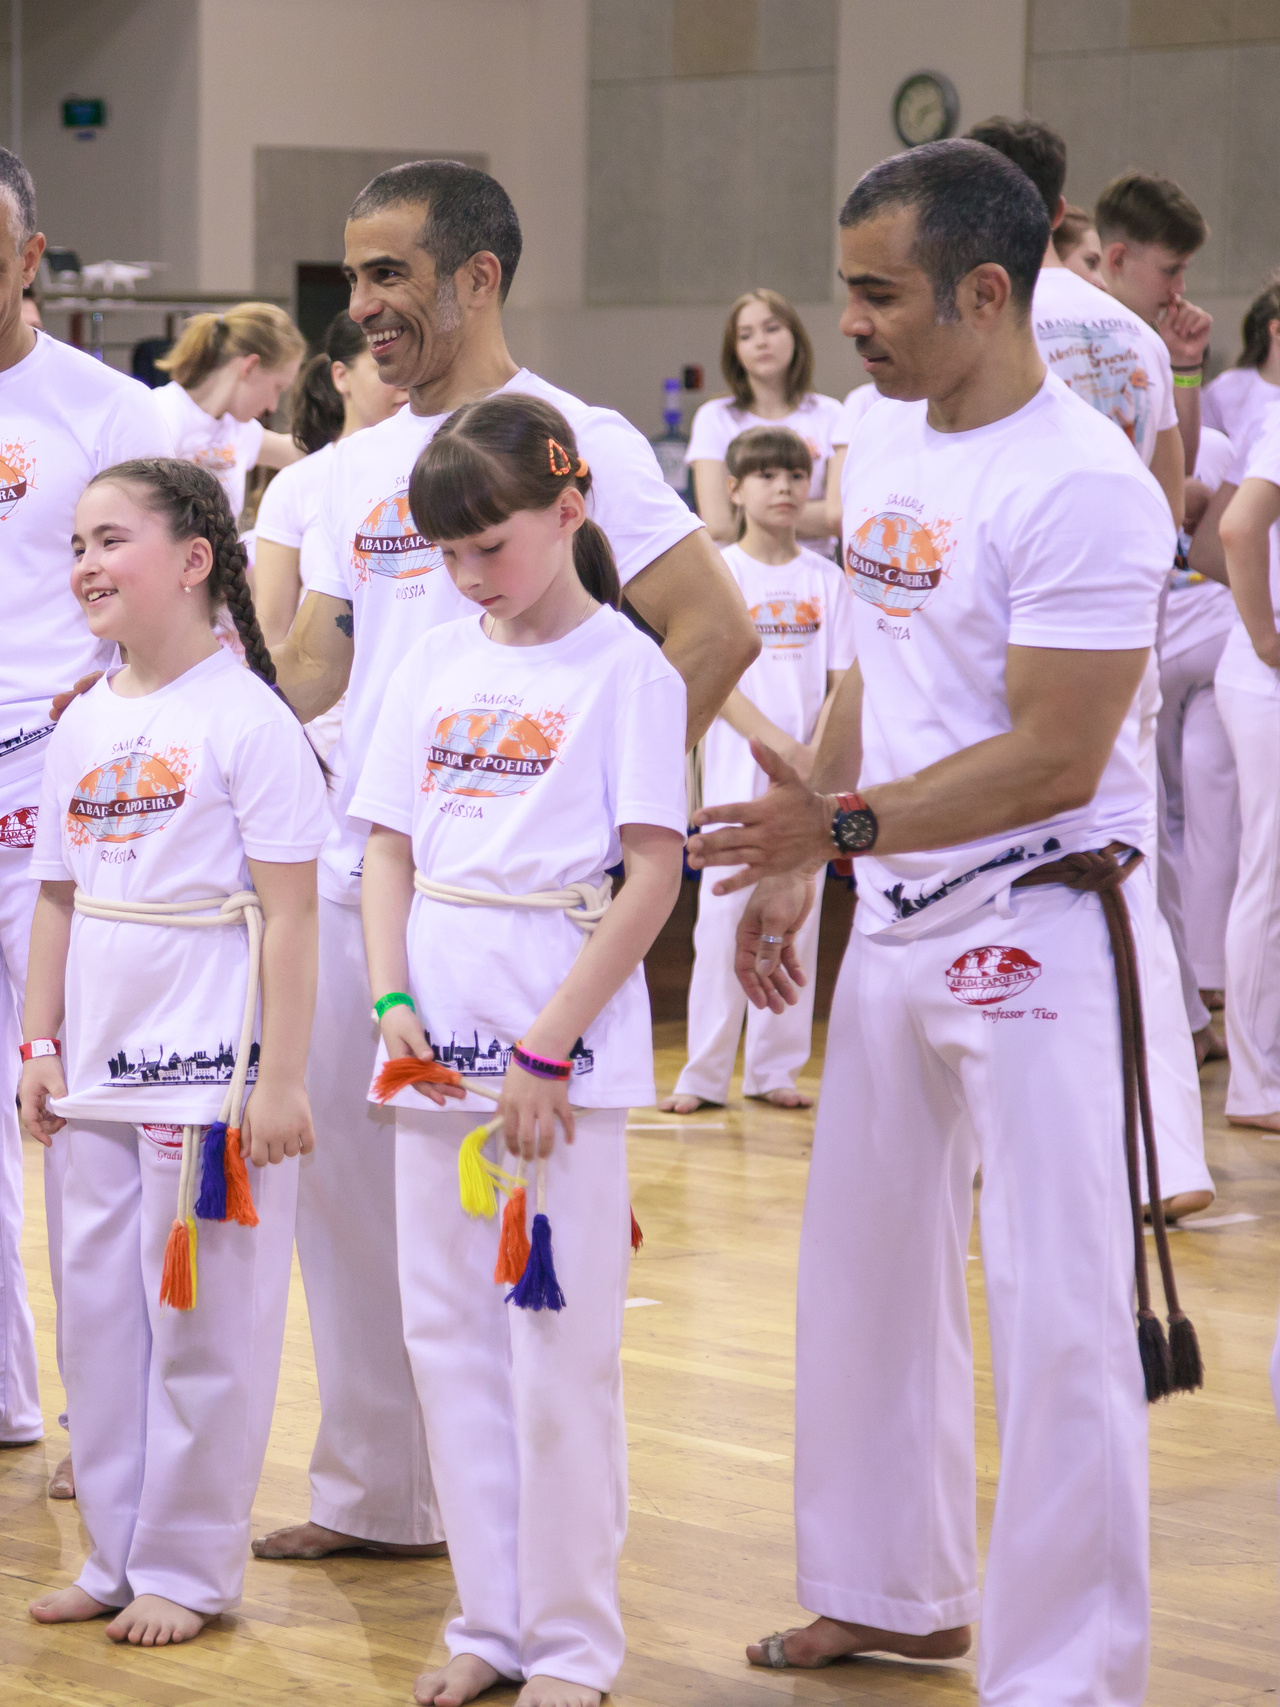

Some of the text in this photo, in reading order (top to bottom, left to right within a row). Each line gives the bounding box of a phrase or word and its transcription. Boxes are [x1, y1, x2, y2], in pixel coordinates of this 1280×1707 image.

[358, 536, 433, 552] ABADÁ-CAPO
[472, 692, 525, 708] SAMARA
[981, 1007, 1059, 1024] Professor Tico
[157, 1149, 183, 1162] Gradu
